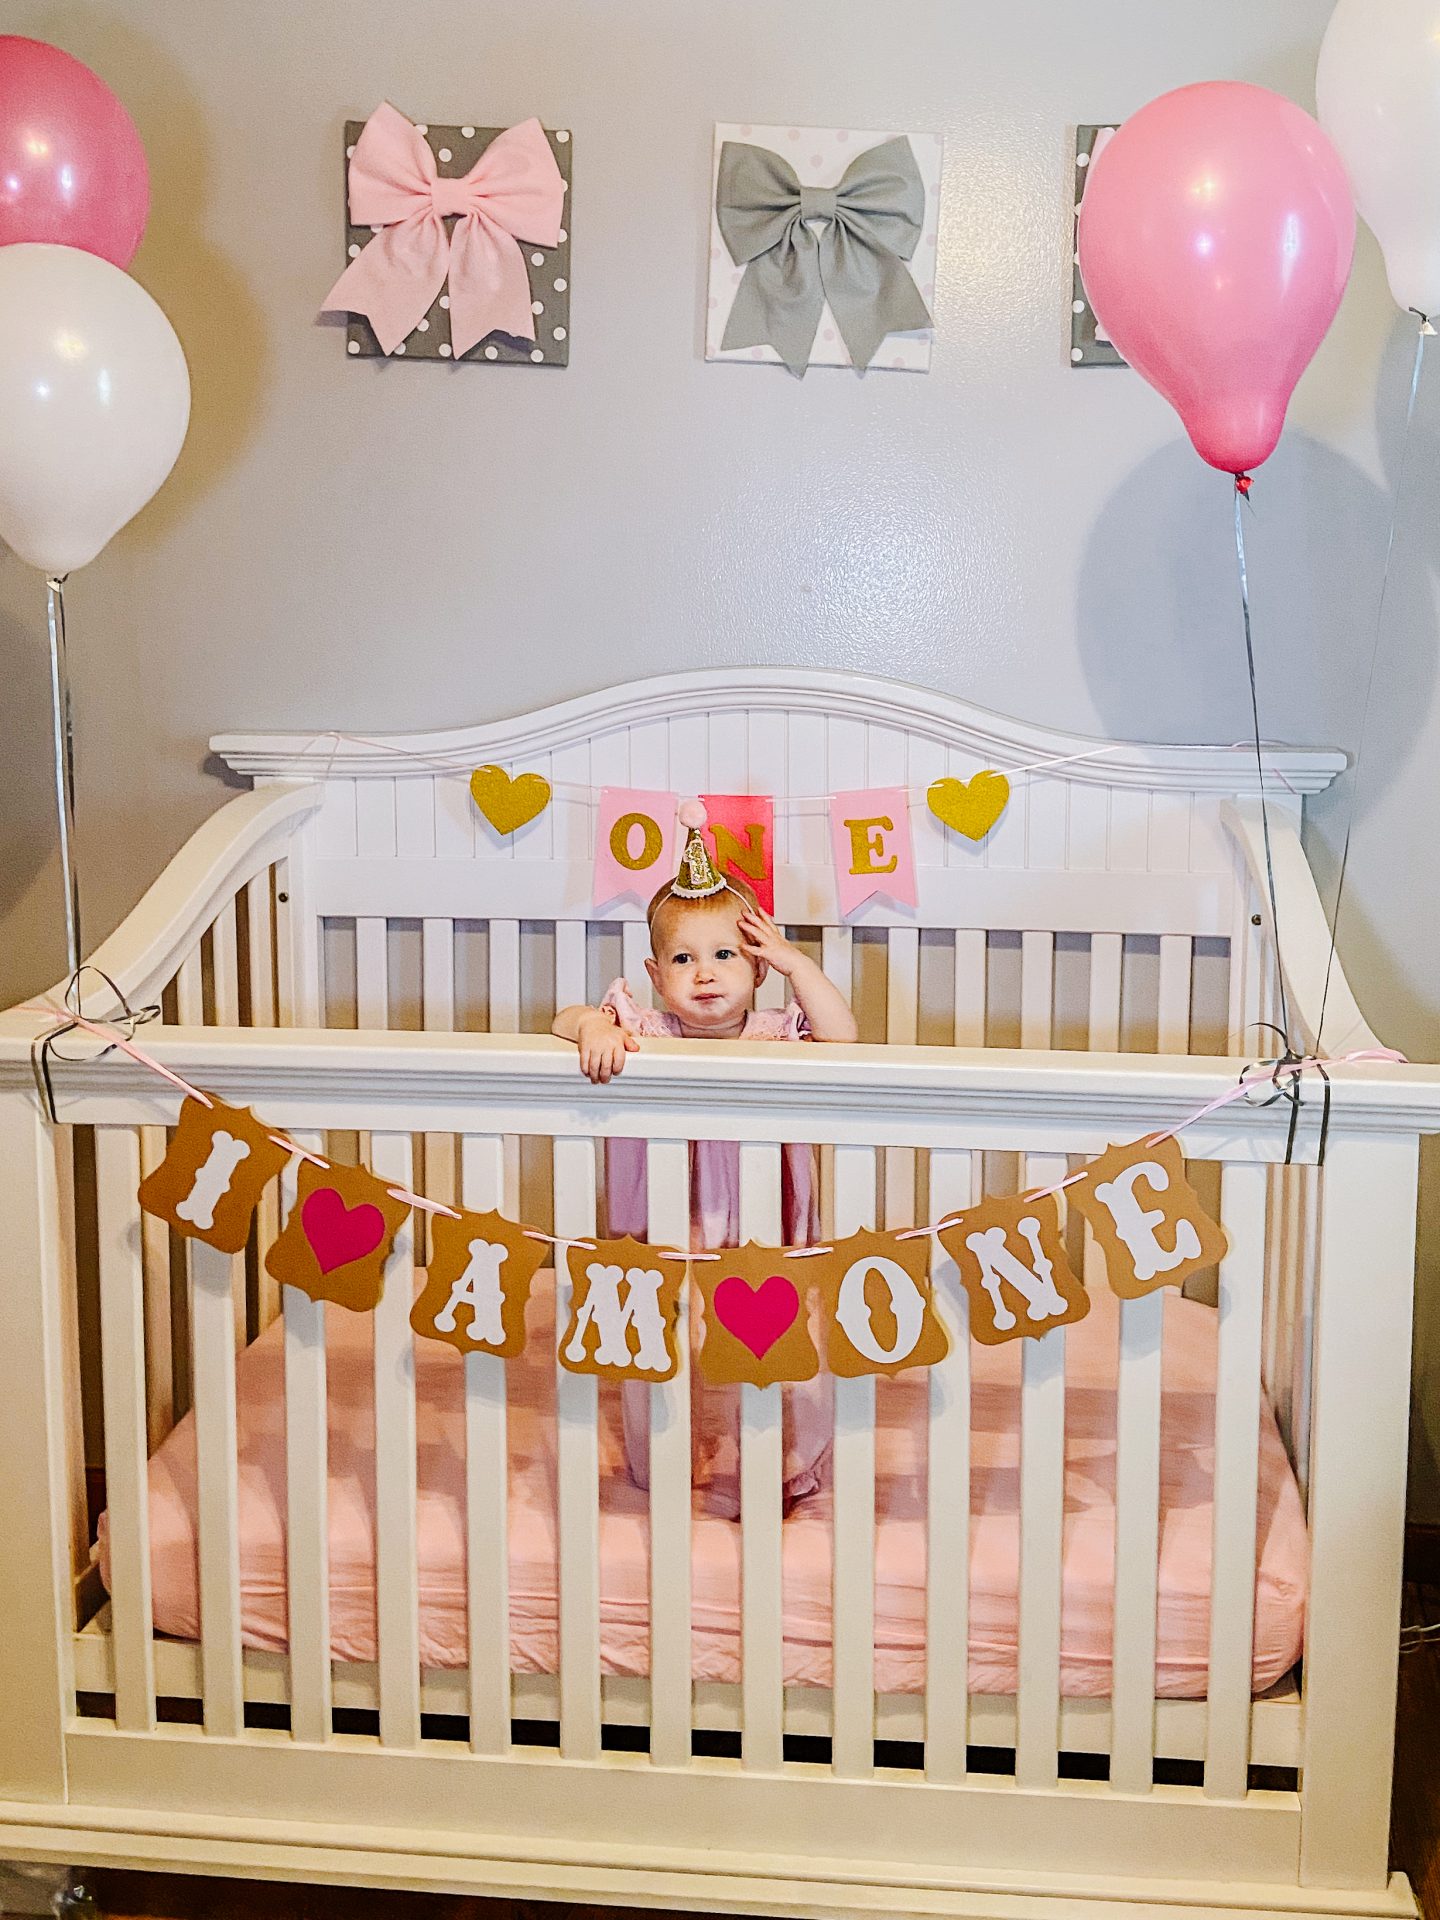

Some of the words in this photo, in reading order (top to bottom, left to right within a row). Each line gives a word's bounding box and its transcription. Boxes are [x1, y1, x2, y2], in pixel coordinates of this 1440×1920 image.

[610, 813, 898, 880] ONE
[683, 839, 708, 885] 1
[175, 1130, 250, 1230] I
[434, 1239, 672, 1372] AM
[835, 1161, 1202, 1364] ONE
